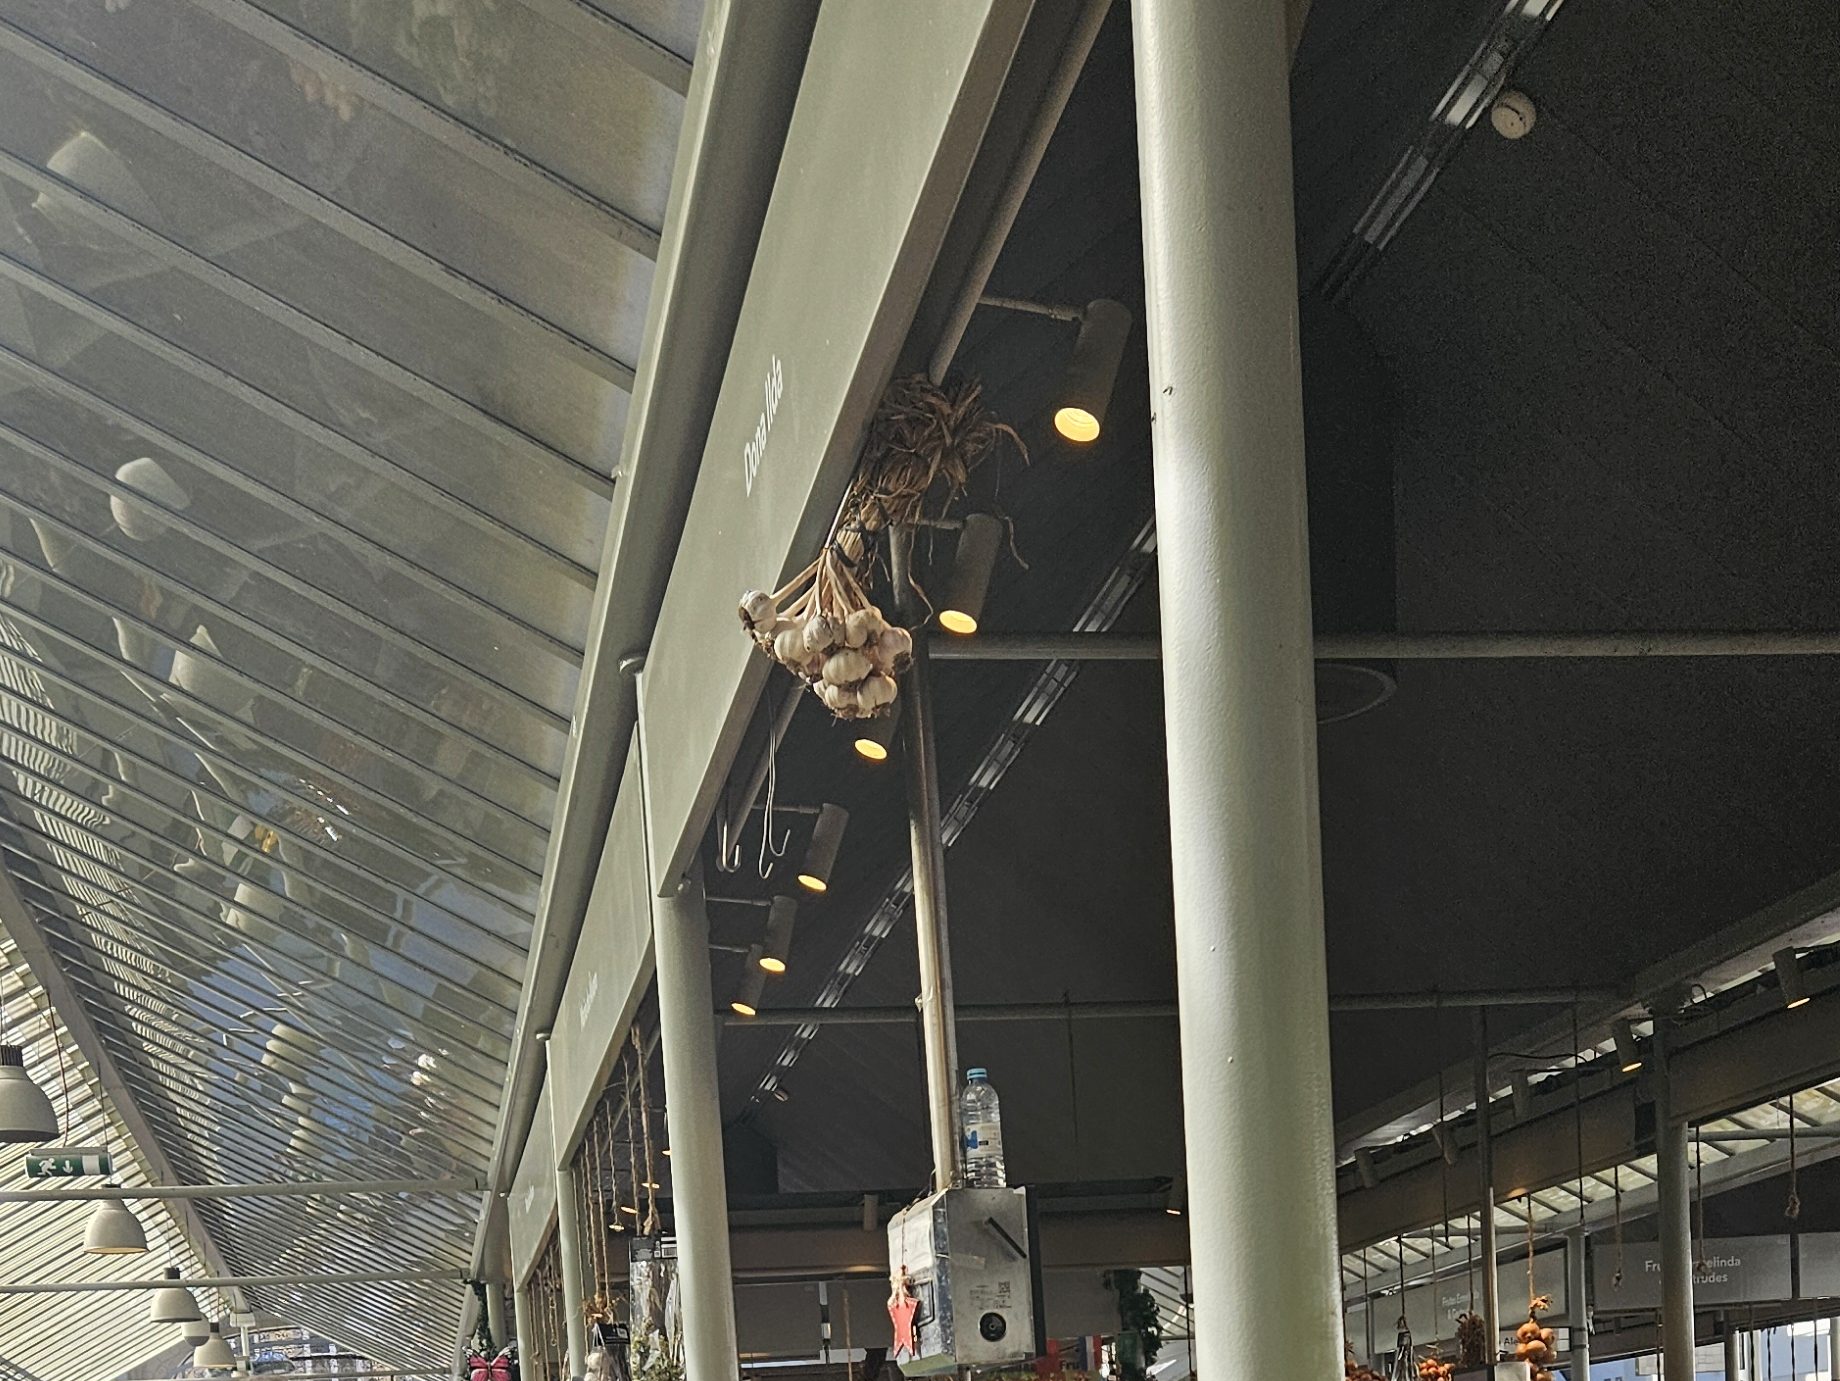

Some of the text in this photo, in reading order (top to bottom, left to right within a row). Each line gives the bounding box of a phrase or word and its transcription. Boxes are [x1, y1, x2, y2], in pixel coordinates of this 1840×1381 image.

[744, 354, 783, 497] Dona Ilda
[1645, 1259, 1661, 1272] Fru
[1693, 1272, 1728, 1284] trudes
